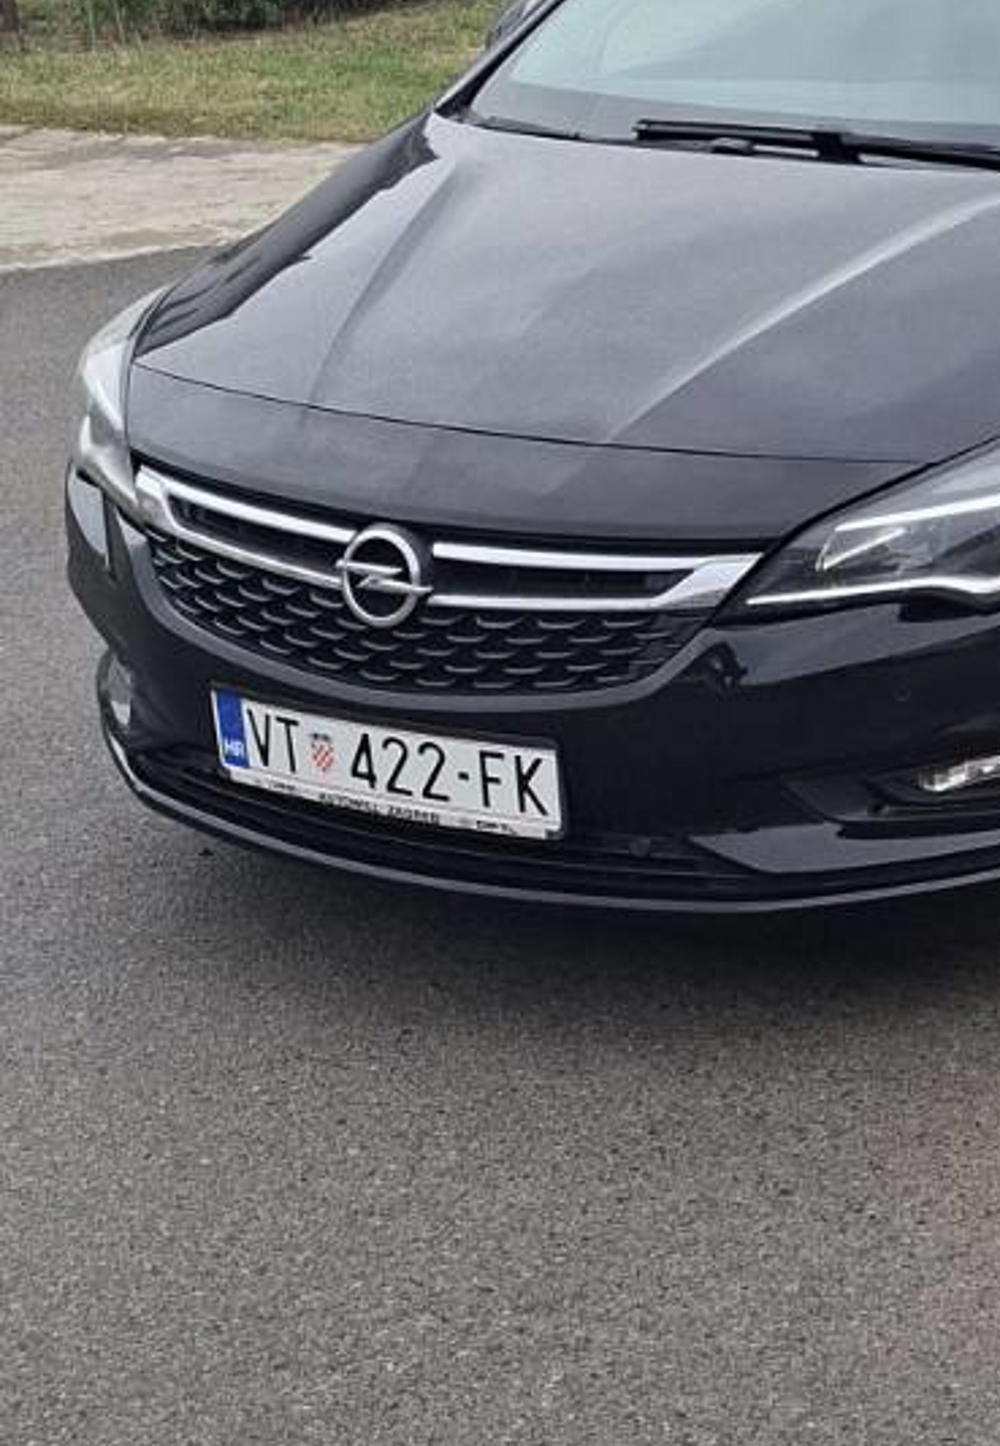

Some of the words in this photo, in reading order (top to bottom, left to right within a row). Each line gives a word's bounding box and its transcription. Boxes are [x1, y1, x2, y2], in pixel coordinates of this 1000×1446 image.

[224, 737, 245, 758] HR
[247, 709, 299, 773] VT
[351, 732, 548, 816] 422-FK
